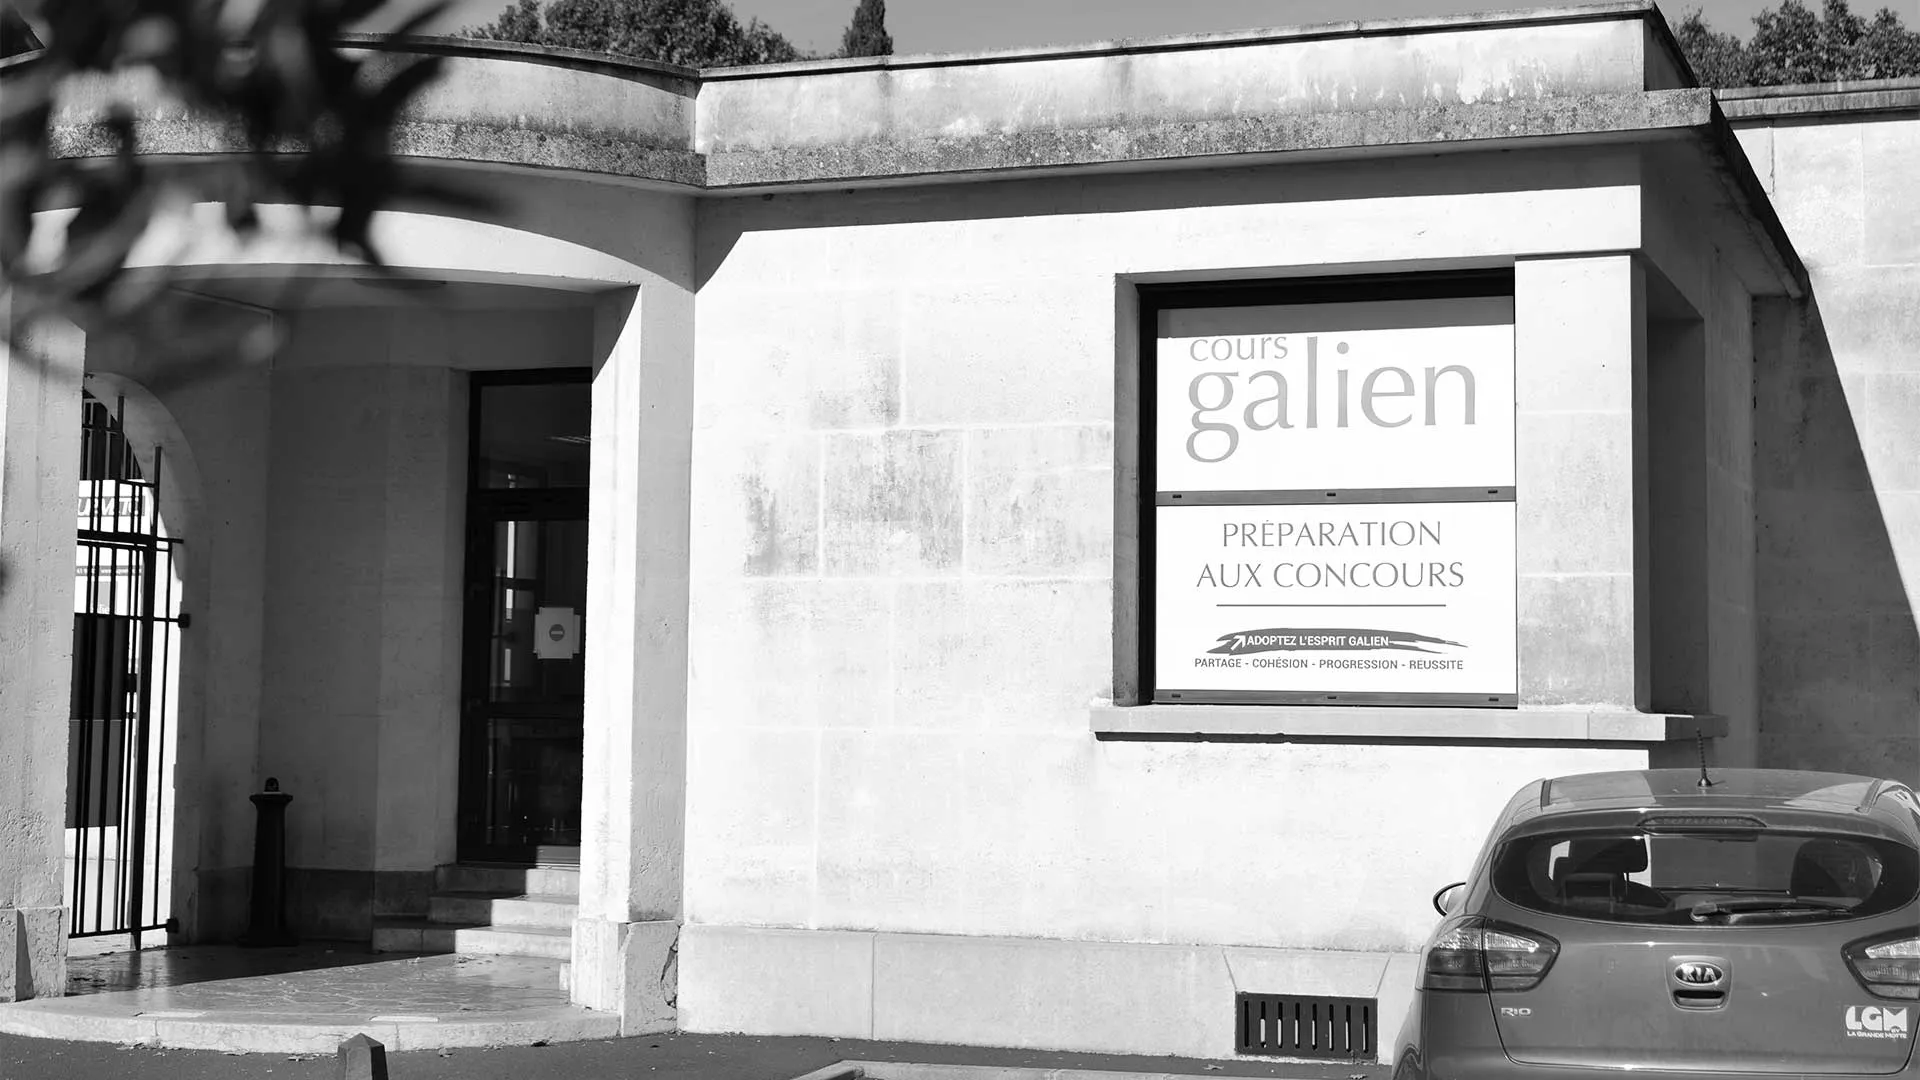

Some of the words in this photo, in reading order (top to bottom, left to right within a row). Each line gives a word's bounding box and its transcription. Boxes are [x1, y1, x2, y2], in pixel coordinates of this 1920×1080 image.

[1190, 336, 1289, 361] cours
[1186, 336, 1476, 463] galien
[1223, 519, 1441, 547] PRÉPARATION
[1197, 563, 1262, 588] AUX
[1274, 562, 1464, 588] CONCOURS
[1247, 635, 1297, 646] ADOPTEZ
[1299, 635, 1346, 647] L'ESPRIT
[1348, 636, 1390, 647] GALIEN
[1195, 658, 1241, 668] PARTAGE
[1252, 656, 1308, 669] COHÉSION
[1319, 659, 1398, 670] PROGRESSION
[1680, 964, 1717, 982] KIA
[1501, 1007, 1532, 1017] RIO
[1845, 1006, 1908, 1032] LGM
